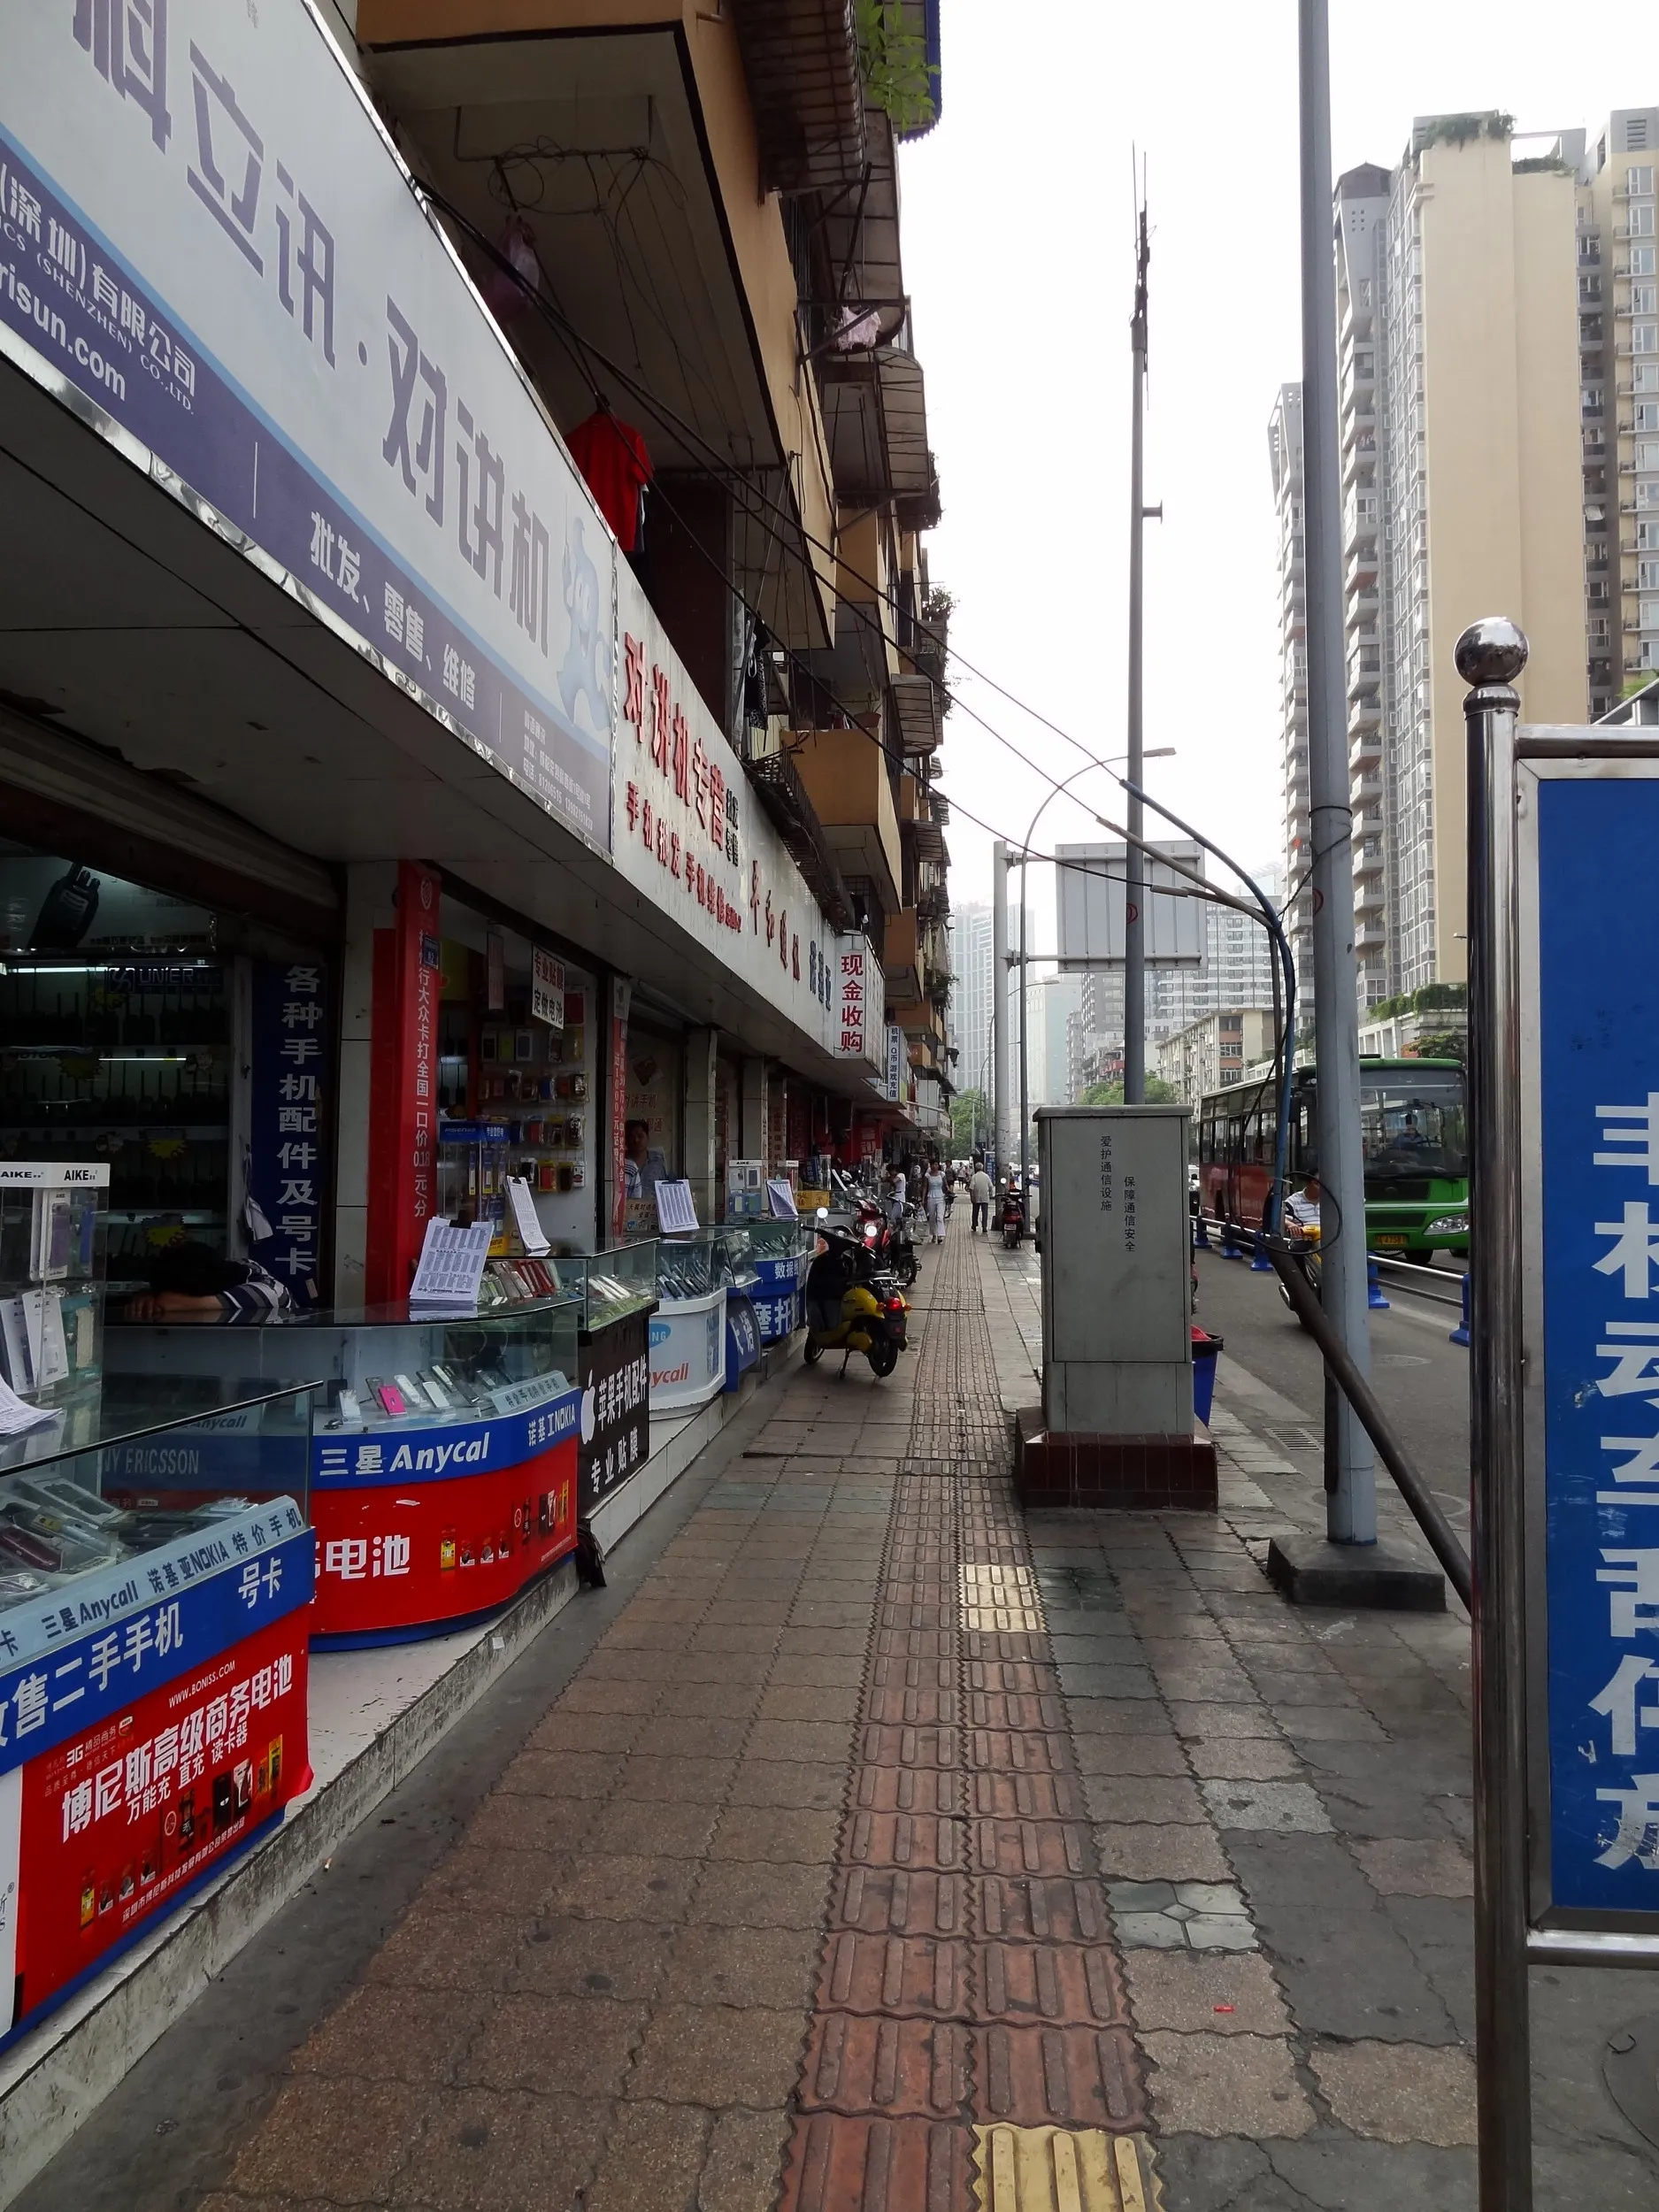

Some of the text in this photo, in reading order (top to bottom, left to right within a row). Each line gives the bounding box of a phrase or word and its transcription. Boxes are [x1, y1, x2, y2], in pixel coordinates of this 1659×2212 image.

[36, 253, 132, 353] (SHENZHEN)
[841, 954, 864, 1053] 现金收购
[274, 964, 324, 1276] 各种手机配件及号卡
[64, 1169, 89, 1181] AIKE
[1100, 1135, 1112, 1212] 爱护通信设施
[1124, 1176, 1136, 1253] 保障通信安全
[597, 1353, 647, 1432] 苹果手机配件
[125, 1448, 200, 1476] ERICSSON
[590, 1425, 639, 1494] 专业贴膜
[231, 1507, 302, 1555] 特价手机
[238, 1556, 282, 1609] 号卡
[168, 1659, 236, 1709] WWW.BONISS.COM
[62, 1653, 293, 1844] 博尼斯高级商务电池
[66, 1743, 84, 1769] 3G
[127, 1720, 249, 1825] 万能充 直充 读卡器
